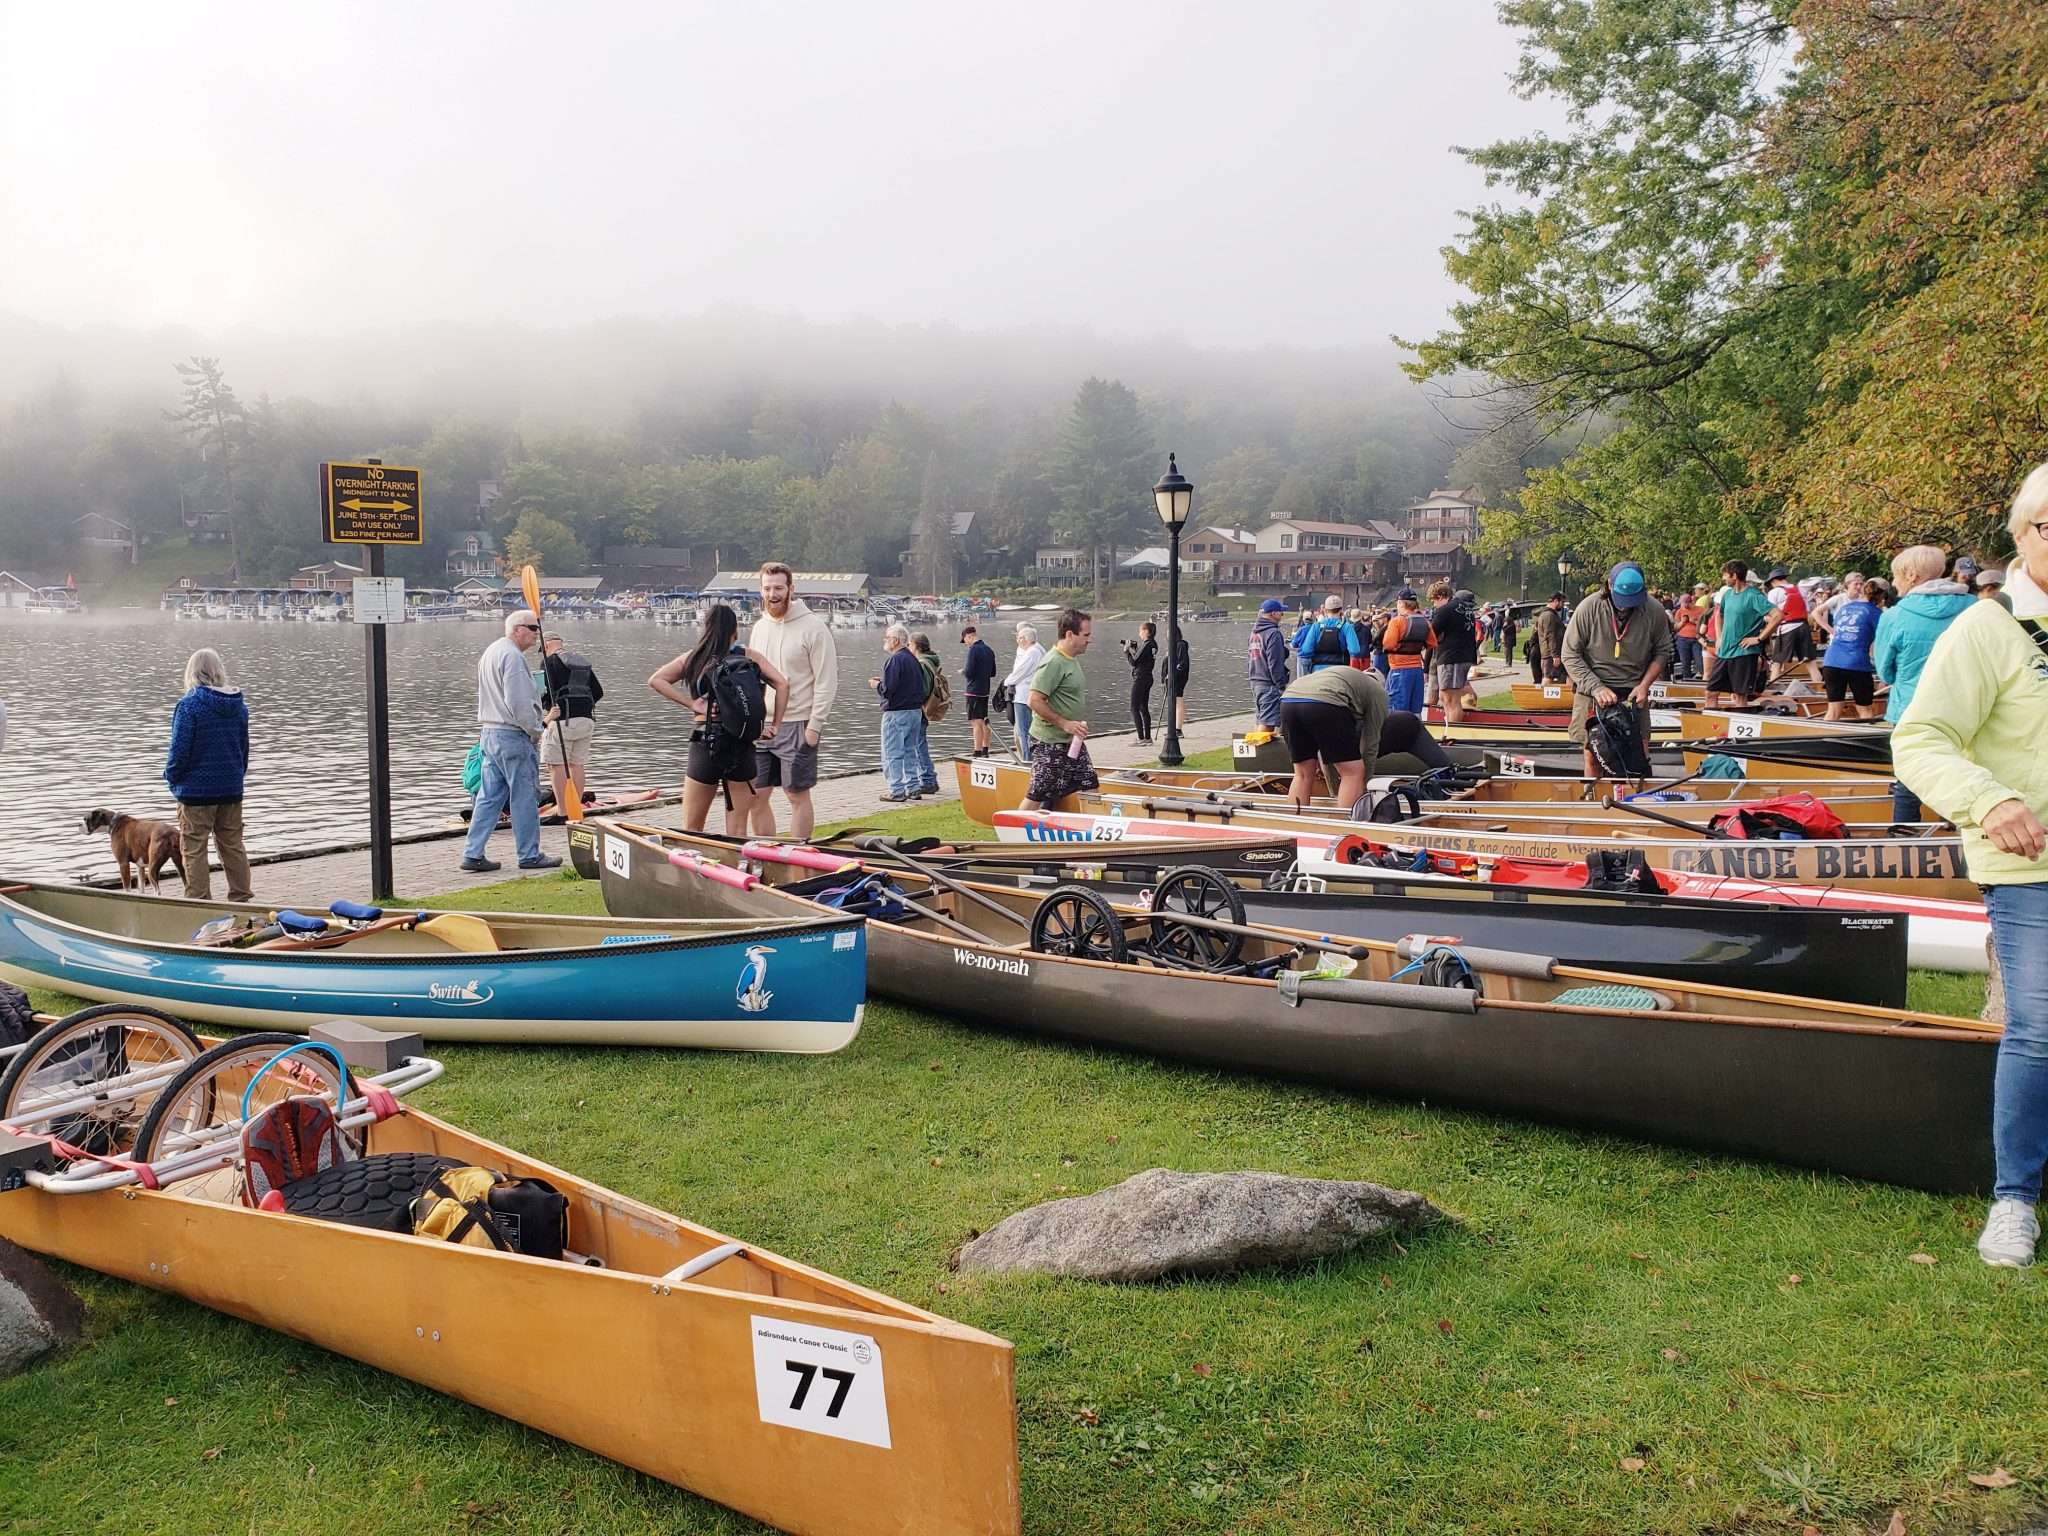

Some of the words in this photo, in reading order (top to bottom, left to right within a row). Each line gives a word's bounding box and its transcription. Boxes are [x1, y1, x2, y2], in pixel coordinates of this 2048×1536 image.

[367, 469, 384, 480] NO
[335, 479, 381, 489] OVERNIGHT
[382, 481, 416, 491] PARKING
[342, 489, 380, 497] MIDNIGHT
[337, 511, 359, 519] JUNE
[379, 513, 399, 521] SEPT.
[400, 513, 416, 521] 15TH
[352, 521, 367, 529] DAY
[367, 521, 382, 529] USE
[382, 521, 402, 530] ONLY
[1736, 725, 1754, 738] 92
[1239, 744, 1249, 754] 81
[1504, 763, 1532, 775] 255
[974, 772, 994, 785] 173
[1095, 826, 1124, 842] 252
[1245, 851, 1284, 861] Shadow
[1503, 841, 1526, 857] cool
[1530, 842, 1558, 859] dude
[612, 850, 624, 870] 30
[1672, 847, 1799, 880] CANOE
[1814, 844, 1971, 879] BELIEV
[429, 983, 462, 999] Swift
[758, 1329, 797, 1343] Adirondack
[798, 1337, 821, 1348] Canoe
[822, 1341, 849, 1353] Classic
[785, 1359, 856, 1419] 77
